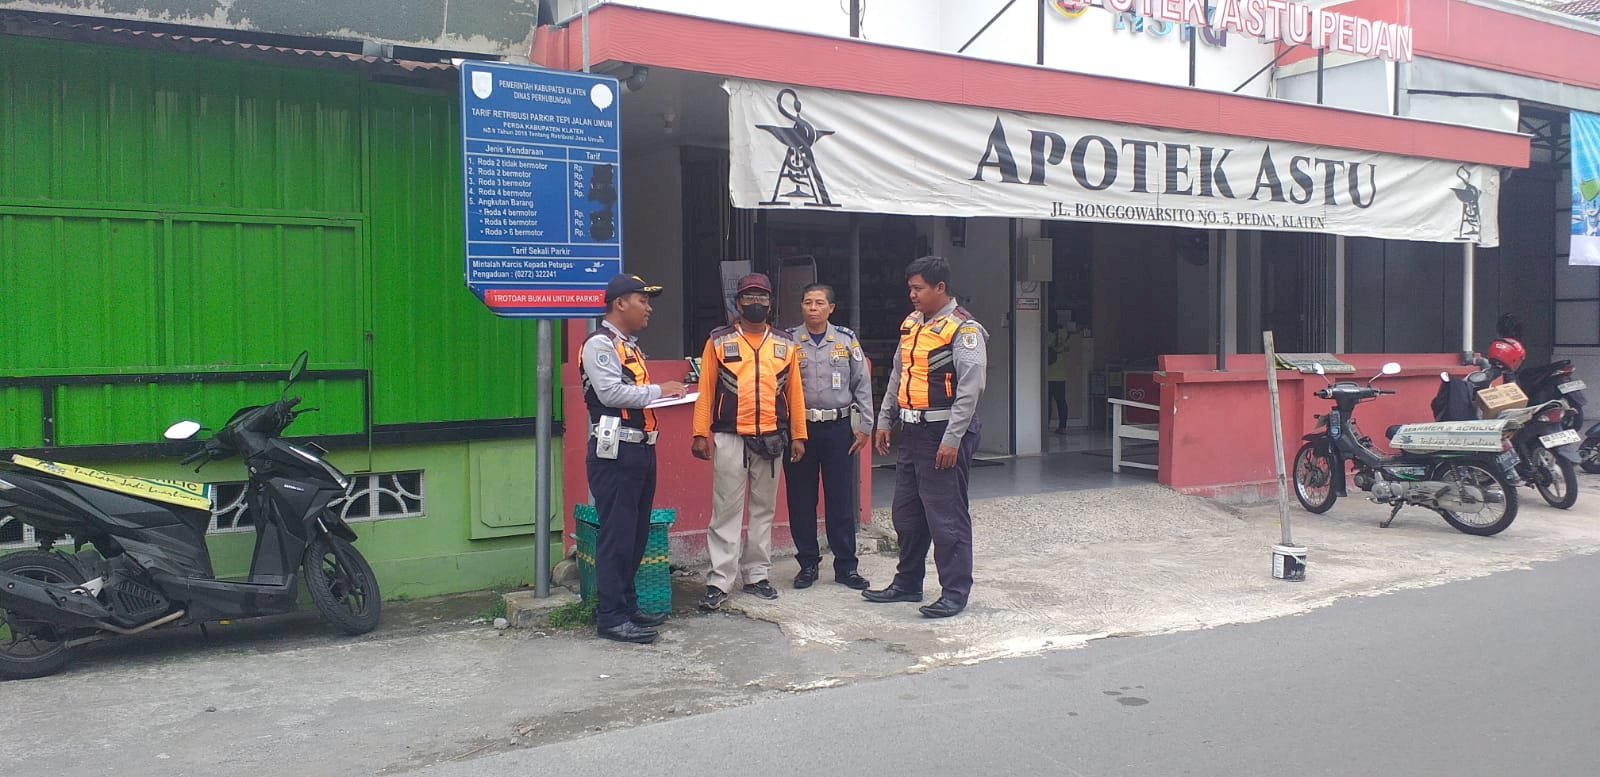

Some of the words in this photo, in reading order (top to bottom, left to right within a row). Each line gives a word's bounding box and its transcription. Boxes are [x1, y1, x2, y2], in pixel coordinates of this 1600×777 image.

[1219, 0, 1308, 43] ASTU
[1319, 10, 1413, 63] PEDAN
[498, 80, 534, 91] PEMERINTAH
[534, 84, 565, 94] KABUPATEN
[566, 86, 586, 96] KLATEN
[514, 92, 530, 101] DINAS
[531, 93, 572, 105] PERHUBUNGAN
[472, 108, 491, 118] TARIF
[492, 110, 529, 121] RETRIBUSI
[530, 113, 555, 122] PARKIR
[556, 116, 570, 124] TEPI
[571, 116, 592, 126] JALAN
[594, 120, 613, 128] UMUM
[503, 122, 524, 130] PERDA
[525, 124, 560, 132] KABUPATEN
[485, 144, 504, 153] Jenis
[506, 146, 544, 156] Kendaraan
[586, 152, 601, 160] Tarif
[478, 158, 495, 166] Roda
[502, 160, 518, 168] tidak
[519, 160, 548, 170] bermotor
[574, 164, 584, 172] Rp.
[968, 114, 1236, 199] APOTEK
[1248, 143, 1377, 209] ASTU
[478, 168, 495, 176] Roda
[502, 170, 531, 178] bermotor
[574, 172, 584, 181] Rp.
[478, 178, 495, 186] Roda
[502, 180, 531, 188] bermotor
[574, 181, 584, 190] Rp.
[478, 188, 496, 196] Roda
[497, 188, 501, 196] 4
[502, 189, 532, 198] bermotor
[574, 190, 584, 198] Rp.
[478, 198, 509, 208] Angkutan
[511, 198, 534, 208] Barang
[484, 208, 501, 216] Roda
[574, 210, 584, 218] Rp.
[1050, 202, 1070, 218] JL.
[1075, 203, 1194, 223] RONGGOWARSITO
[1198, 210, 1220, 225] NO.
[1223, 212, 1234, 226] 5,
[1236, 212, 1279, 228] PEDAN,
[1282, 215, 1325, 229] KLATEN
[484, 218, 502, 226] Roda
[508, 218, 538, 226] bermotor
[574, 219, 584, 227] Rp.
[485, 228, 502, 236] Roda
[574, 228, 585, 238] Rp.
[512, 246, 527, 255] Tarif
[528, 246, 549, 255] Sekali
[551, 247, 570, 255] Parkir
[472, 260, 500, 268] Mintalah
[501, 260, 522, 268] Karcis
[523, 261, 547, 269] Kepada
[548, 261, 573, 270] Petugas
[473, 270, 510, 279] Pengaduan
[514, 270, 534, 279] (0272)
[535, 270, 557, 278] 322241
[494, 294, 527, 302] TROTOAR
[528, 294, 551, 302] BUKAN
[552, 294, 575, 302] UNTUK
